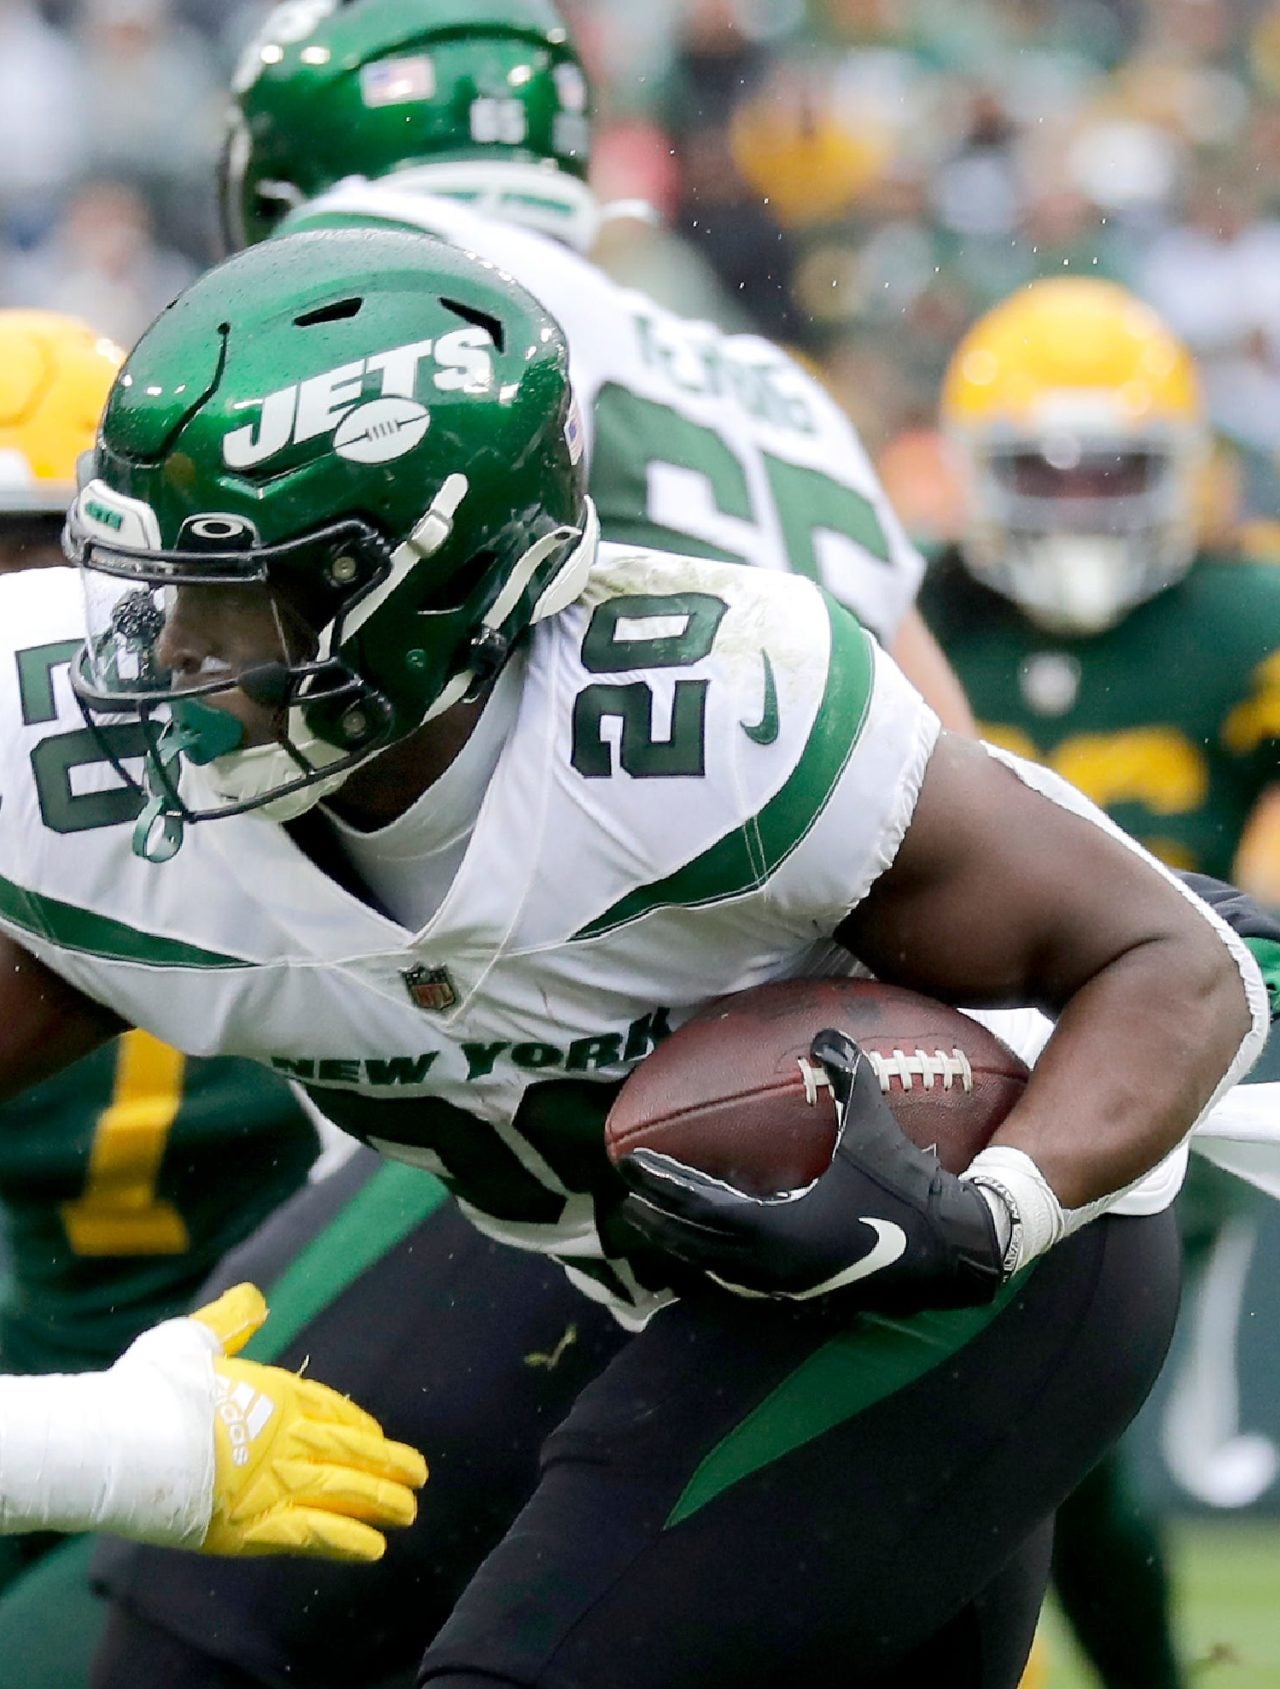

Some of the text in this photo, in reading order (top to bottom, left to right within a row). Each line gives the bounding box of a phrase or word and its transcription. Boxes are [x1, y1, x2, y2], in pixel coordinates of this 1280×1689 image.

[222, 328, 492, 471] JETS
[570, 592, 730, 779] 20
[270, 1006, 673, 1086] NEW YORK
